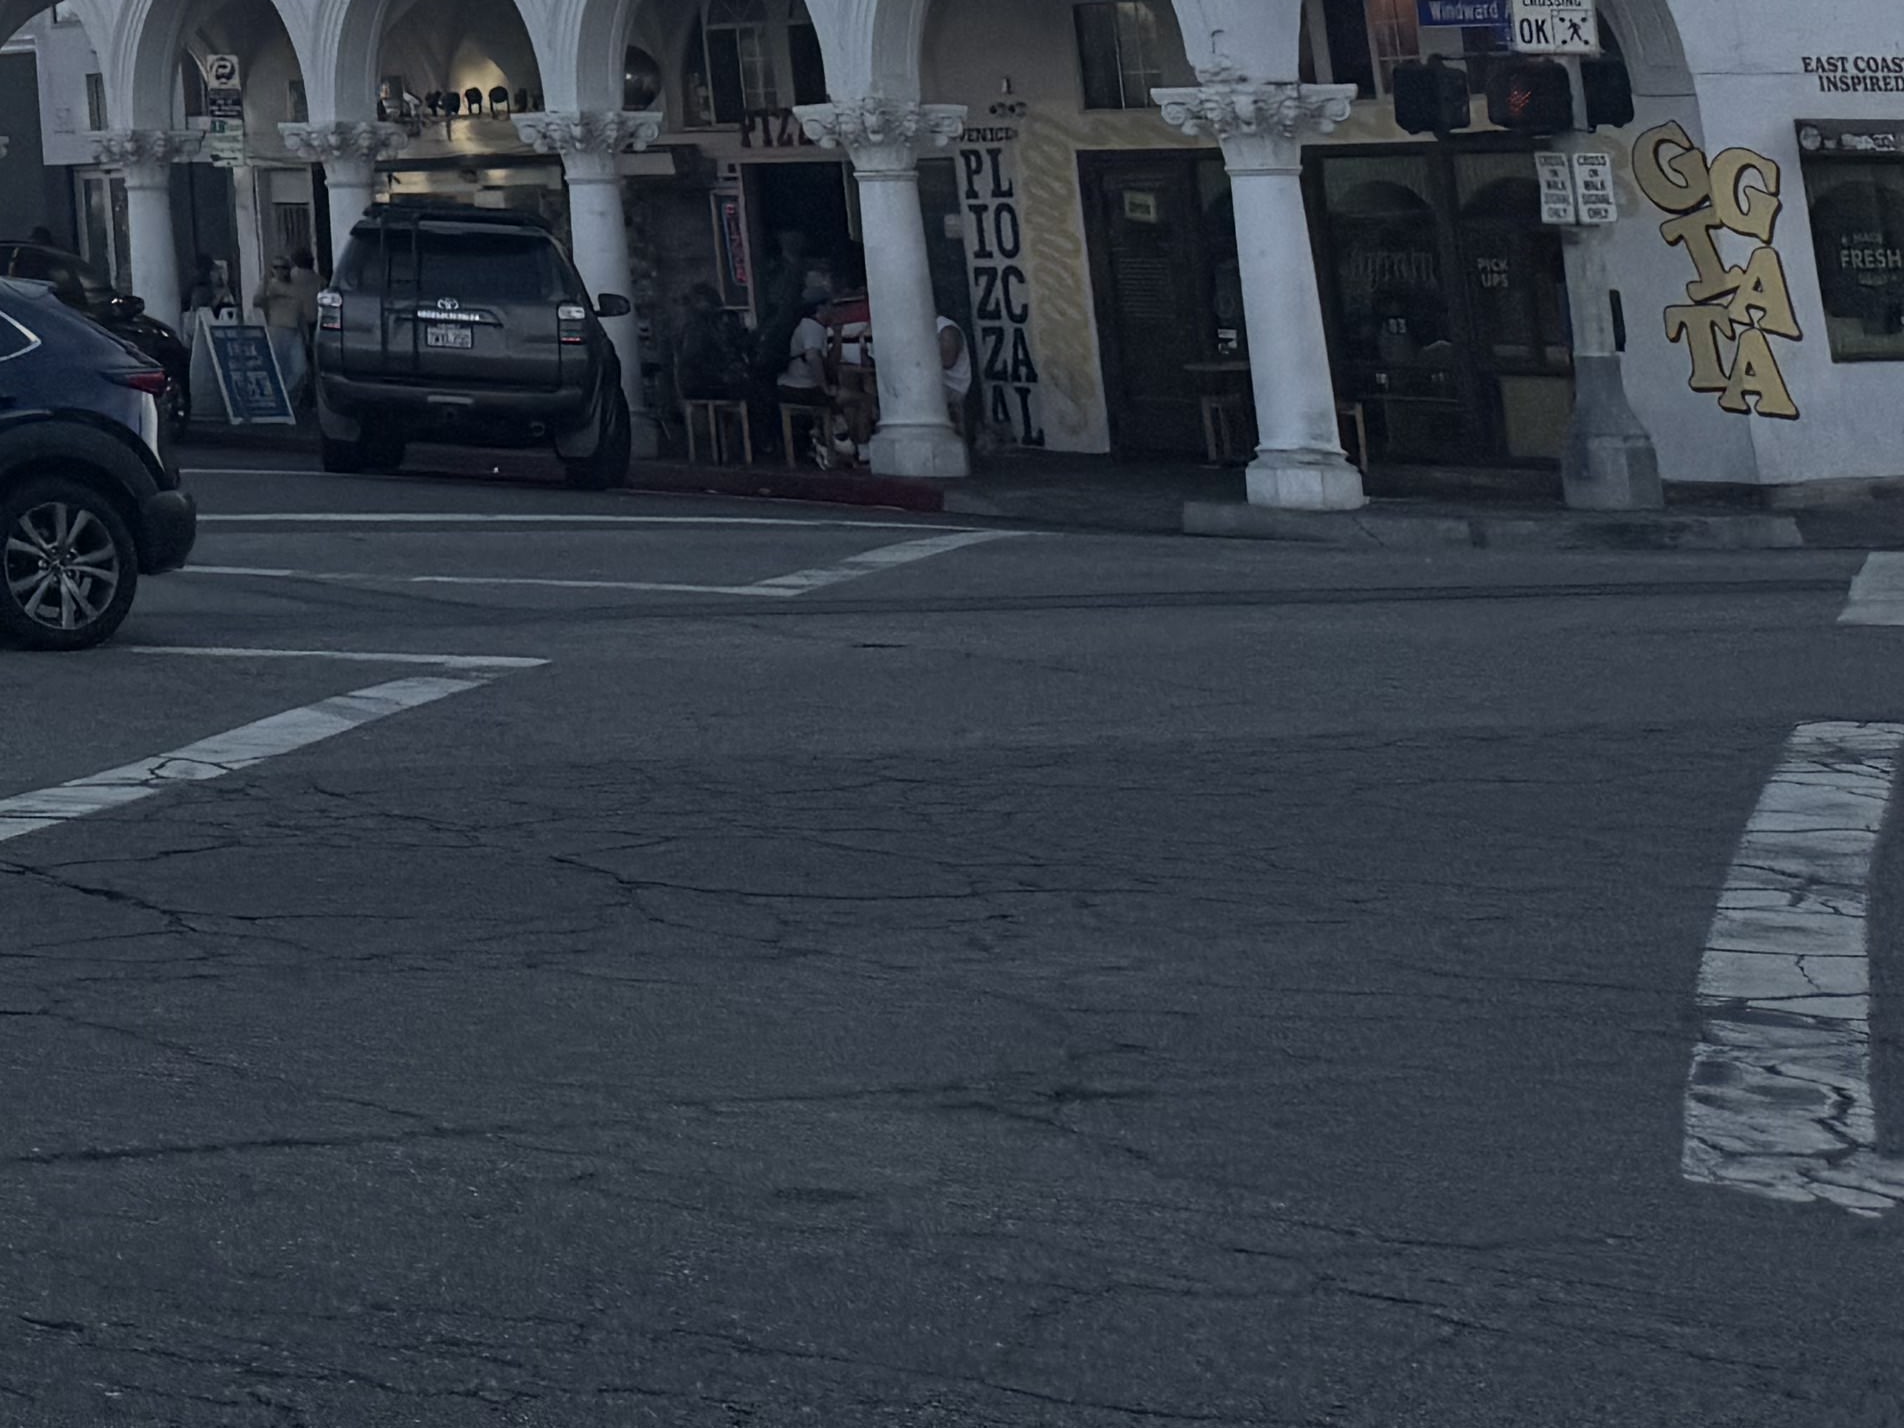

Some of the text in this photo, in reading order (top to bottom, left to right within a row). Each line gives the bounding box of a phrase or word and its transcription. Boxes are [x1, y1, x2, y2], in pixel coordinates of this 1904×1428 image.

[1430, 0, 1498, 21] Windward
[1519, 17, 1550, 45] OK
[1801, 56, 1904, 73] EAST COAS
[1818, 75, 1904, 92] INSPIRED
[1476, 256, 1509, 272] PICK
[1839, 248, 1902, 269] FRESH
